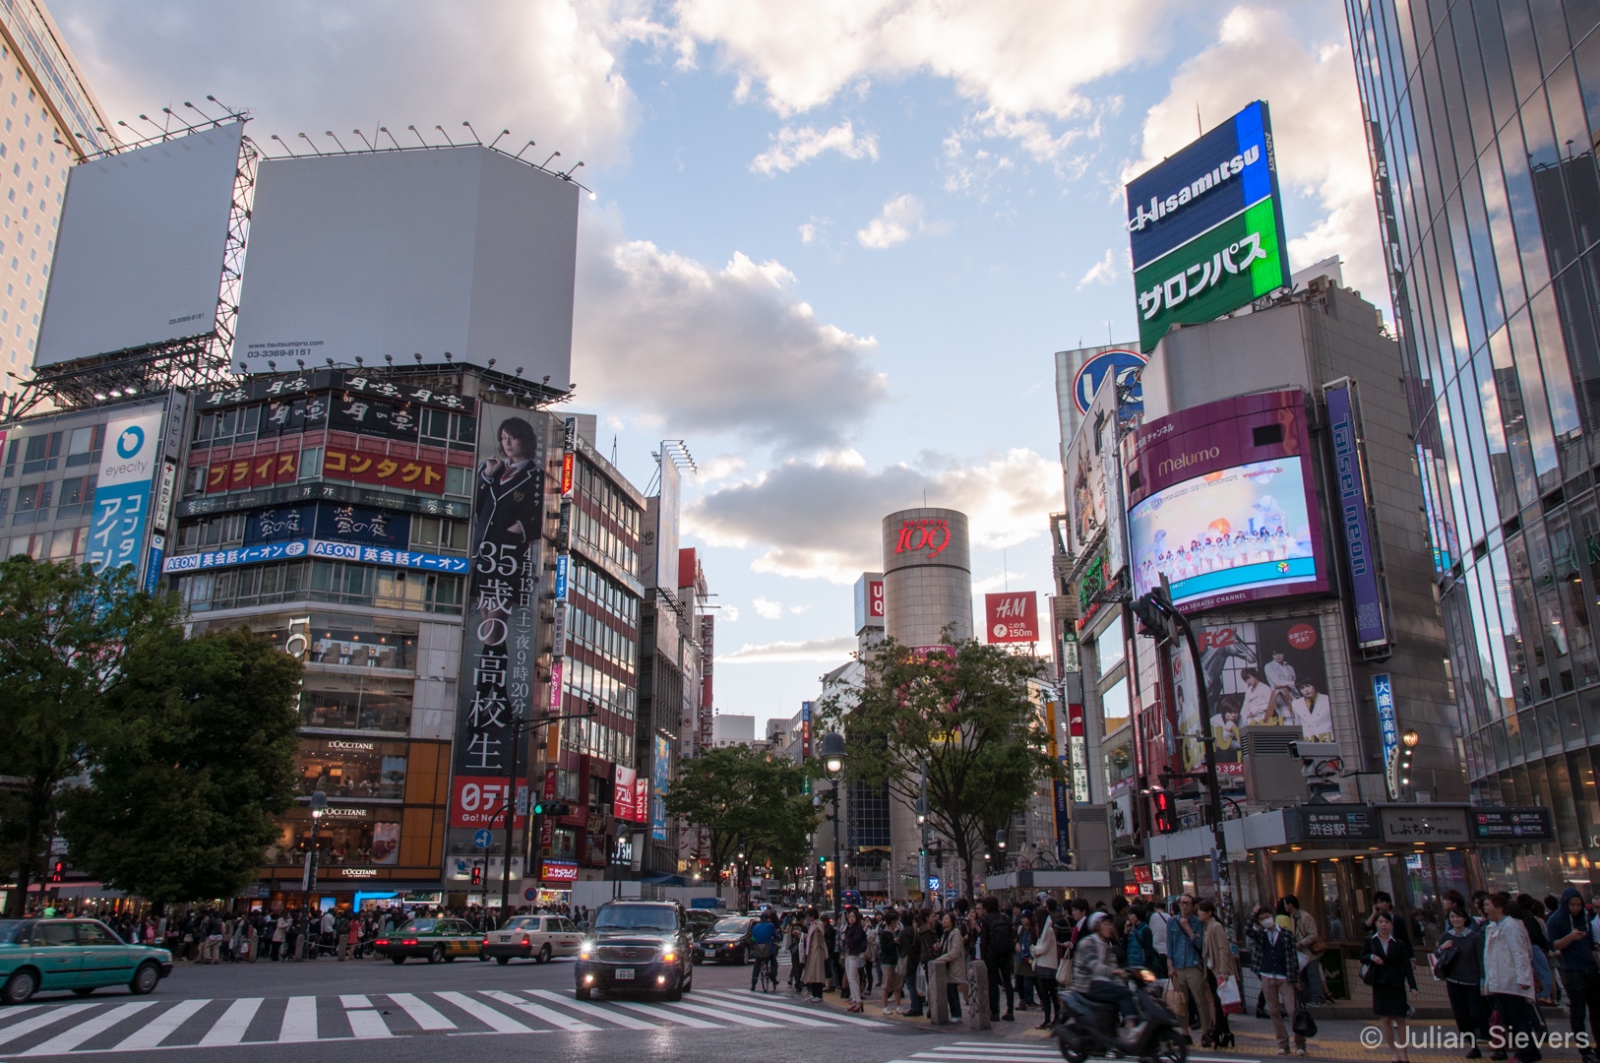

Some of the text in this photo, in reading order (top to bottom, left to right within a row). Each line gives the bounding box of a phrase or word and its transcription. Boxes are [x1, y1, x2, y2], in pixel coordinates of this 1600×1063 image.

[1126, 144, 1260, 232] Hisamitsu
[1138, 232, 1267, 320] サロンパス
[248, 340, 324, 349] www.tsutsumipro.com
[247, 349, 311, 358] 03-3369-8151
[105, 460, 149, 477] eyecity
[209, 453, 296, 486] プライス
[325, 451, 442, 486] コンタクト
[303, 488, 312, 496] 7F
[323, 487, 334, 496] 7F
[1332, 412, 1367, 576] Taisei neon
[903, 519, 948, 527] SHIBUYA
[894, 525, 951, 558] 109
[202, 543, 301, 567] 英会話イーオン 6F
[313, 542, 356, 558] AEON
[166, 556, 198, 570] AEON
[363, 548, 466, 572] 英会話イーオン
[1215, 592, 1248, 604] CHANNEL
[996, 597, 1027, 619] H&M
[1009, 629, 1033, 638] 150m
[465, 541, 518, 770] 35歳の高校生
[328, 740, 374, 750] L'OCCITANE
[616, 786, 632, 803] アコム
[321, 806, 368, 817] L'OCCITANE
[462, 813, 505, 822] Go! Next
[1309, 823, 1347, 836] 渋谷駅
[1389, 823, 1435, 836] しぶちか
[342, 868, 378, 876] L'OCCITANE
